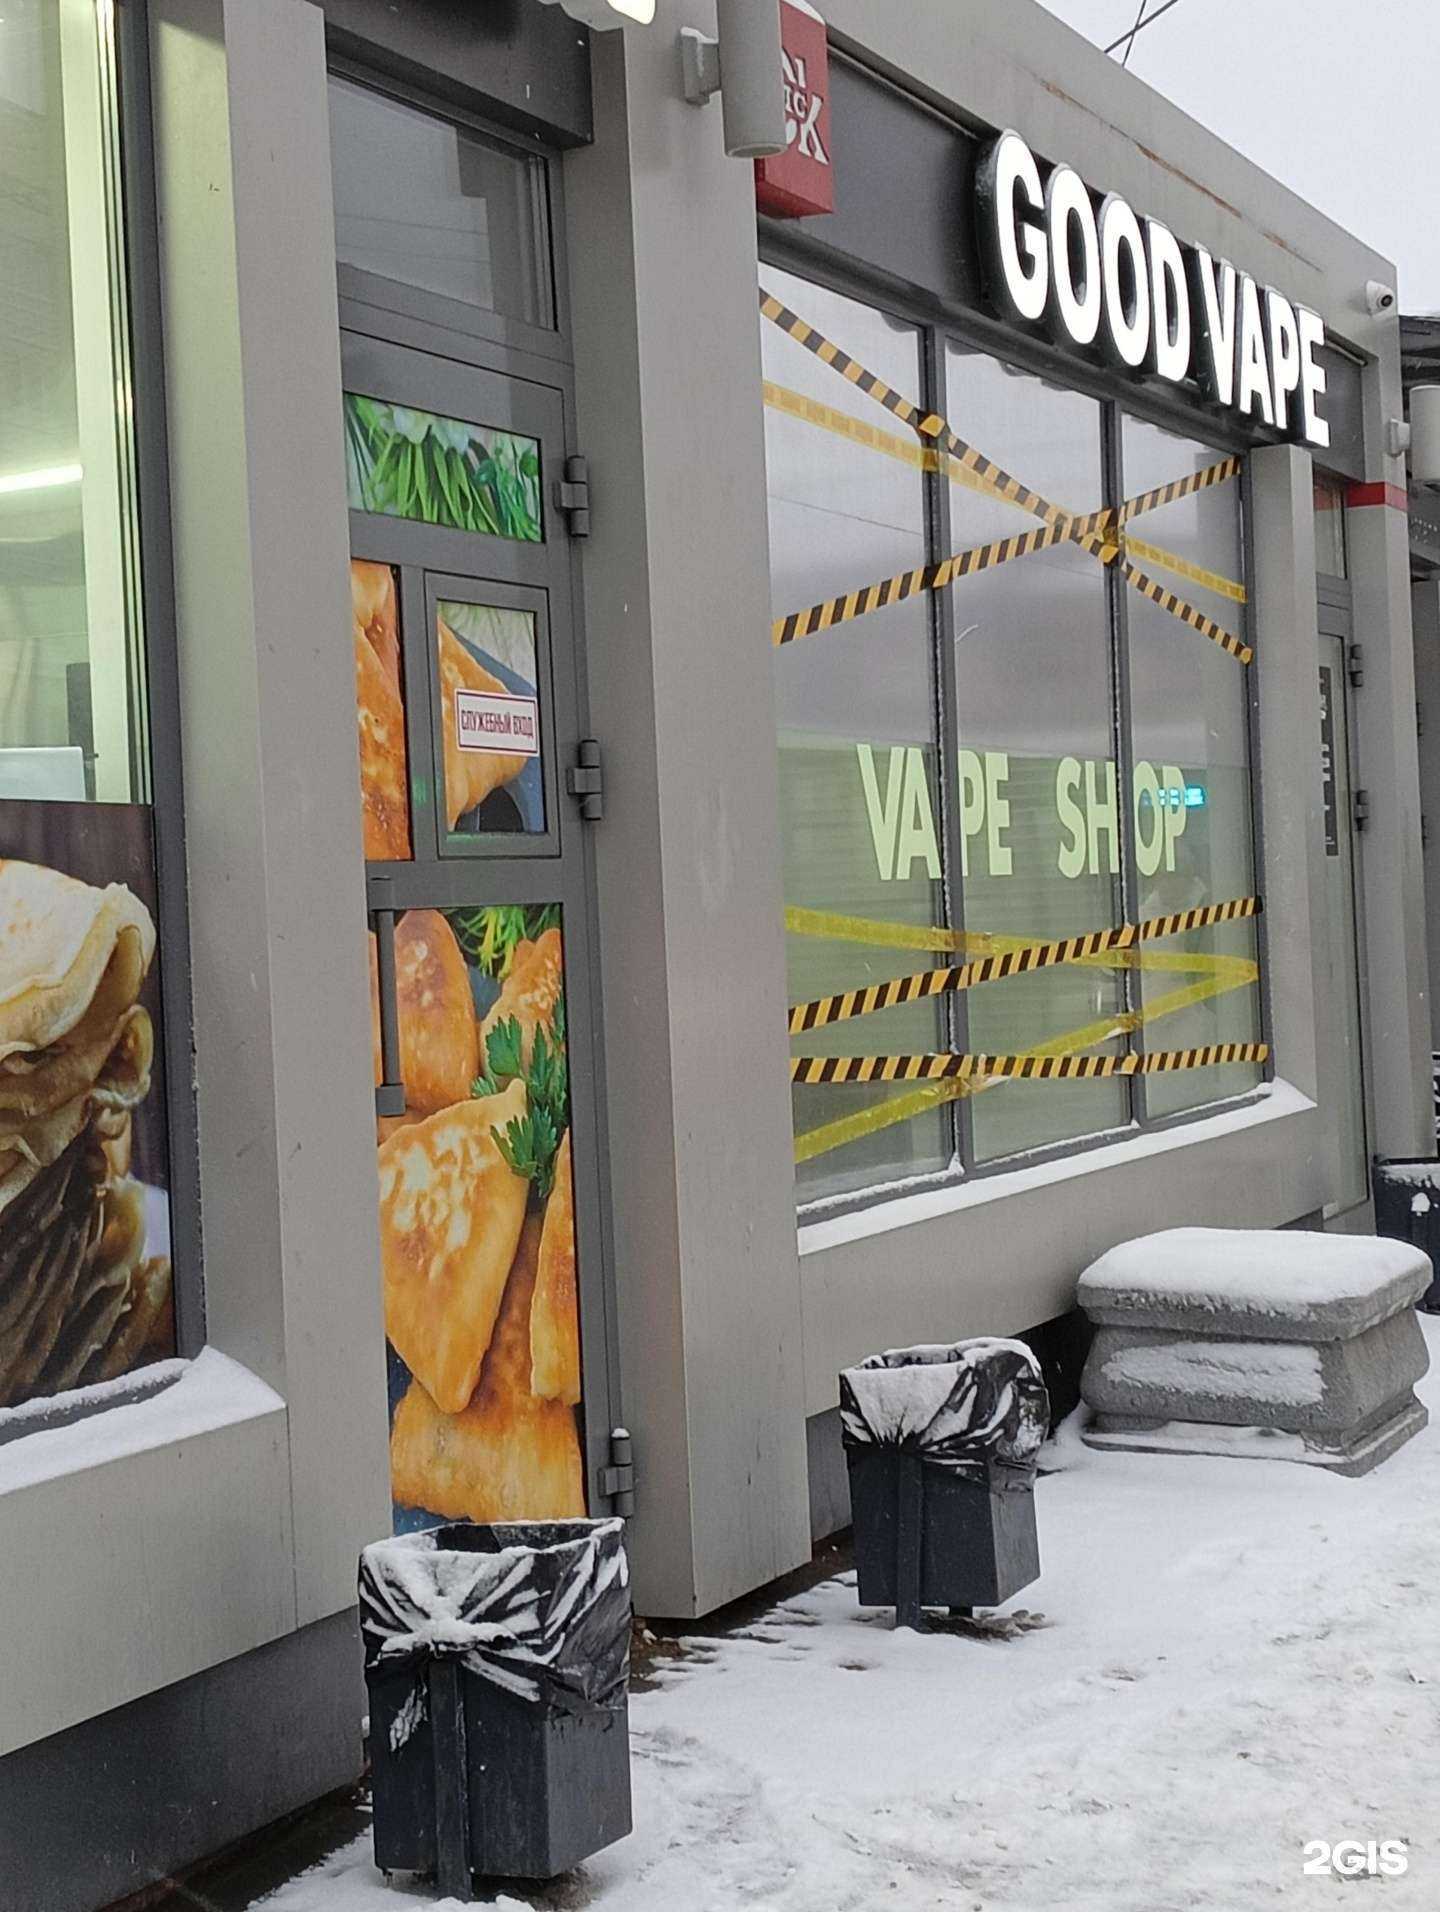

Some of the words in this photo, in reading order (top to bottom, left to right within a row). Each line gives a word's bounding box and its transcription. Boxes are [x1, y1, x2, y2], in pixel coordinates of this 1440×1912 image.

[996, 134, 1192, 382] GOOD
[1198, 247, 1331, 449] VAPE
[461, 710, 511, 734] СЛУЖЕБНЫЙ
[856, 743, 1013, 880] VAPE
[1056, 756, 1187, 878] SHOP
